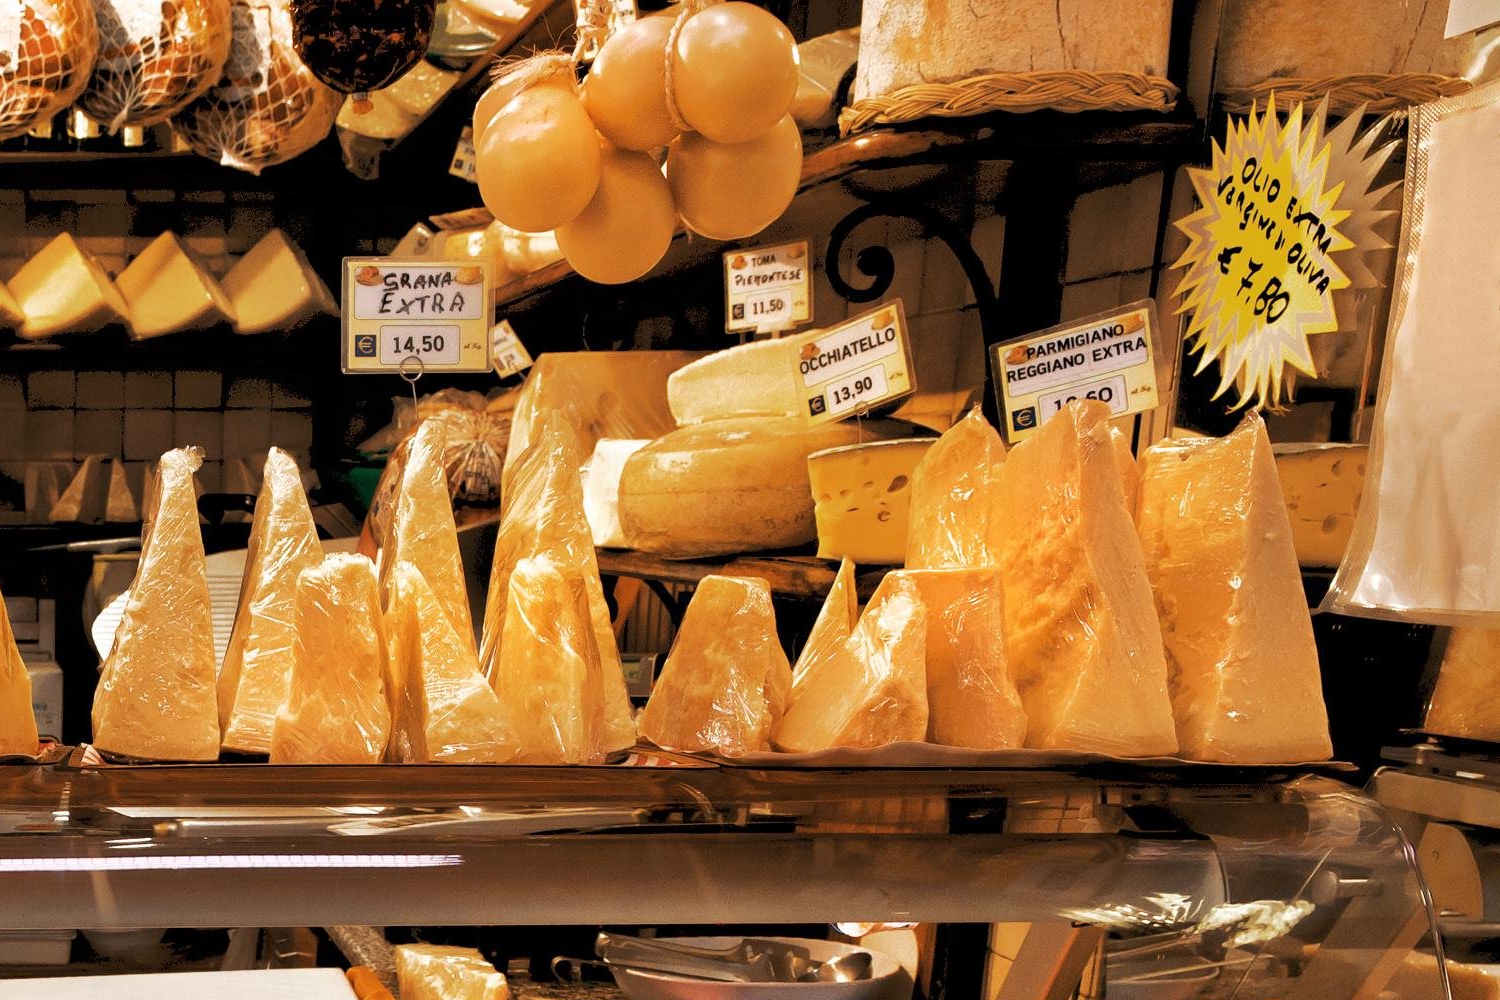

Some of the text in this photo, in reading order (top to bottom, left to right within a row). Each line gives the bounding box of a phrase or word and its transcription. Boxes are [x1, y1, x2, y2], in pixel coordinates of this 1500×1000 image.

[1242, 157, 1280, 203] OLIO
[751, 254, 777, 268] TOMA
[1288, 242, 1331, 295] OLIVA
[383, 271, 453, 291] GRANA
[734, 268, 802, 286] PIEMONTESE
[378, 292, 466, 315] EXTRA
[752, 299, 784, 315] 11,50
[393, 335, 445, 355] 14,50
[800, 327, 896, 375] OCCHIATELLO
[1026, 324, 1125, 361] PARMIGIANO
[1007, 337, 1147, 383] REGGIANO EXTRA
[833, 376, 873, 405] 13,90
